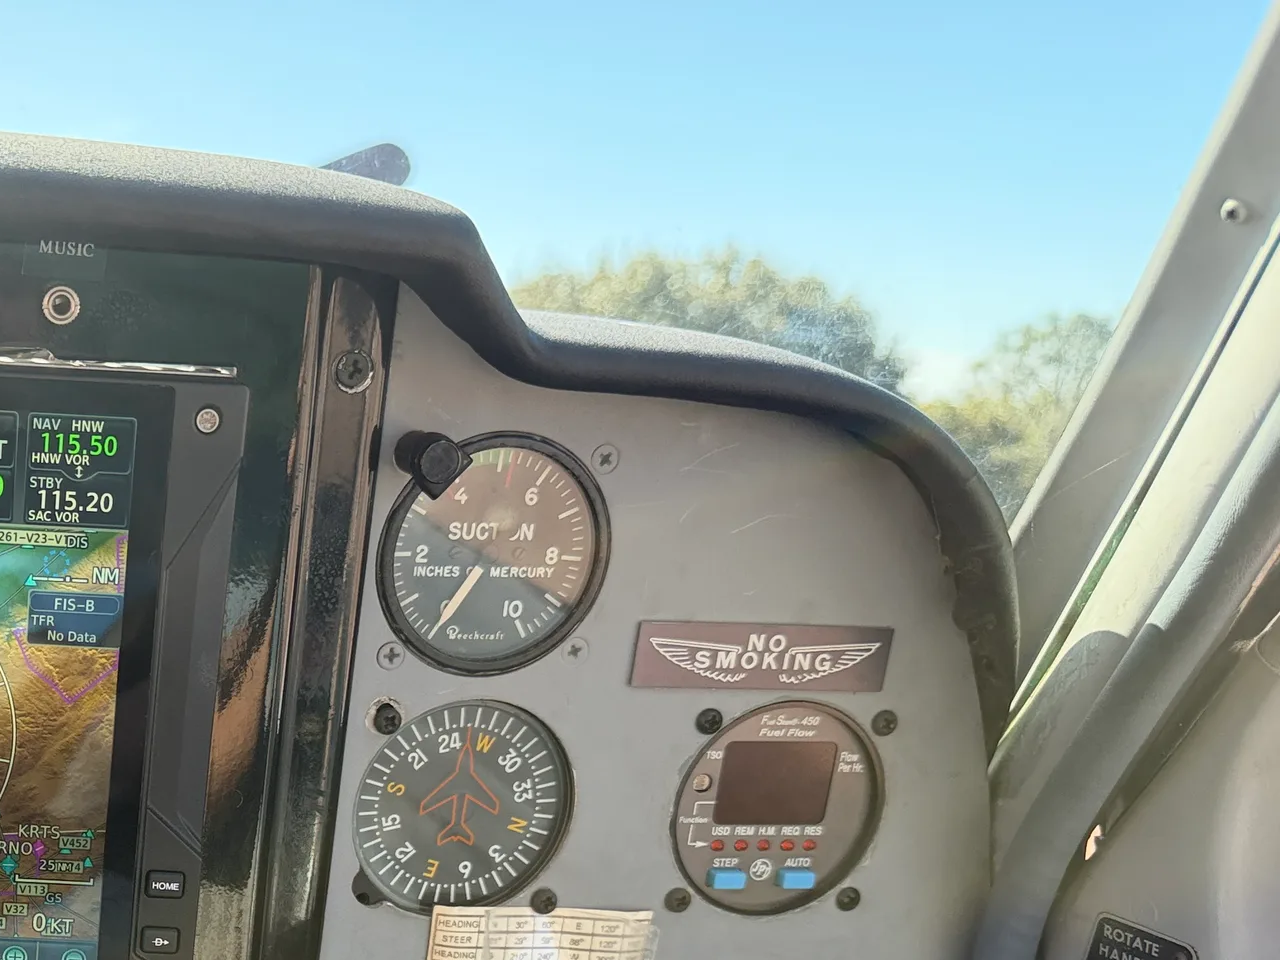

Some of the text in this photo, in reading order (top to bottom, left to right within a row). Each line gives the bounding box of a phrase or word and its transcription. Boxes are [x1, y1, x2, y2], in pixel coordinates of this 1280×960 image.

[39, 240, 94, 257] MUSIC
[33, 418, 104, 432] NAV HNW
[41, 432, 118, 456] 115.50
[29, 477, 63, 490] STBY
[38, 490, 113, 512] 115.20
[525, 487, 538, 505] 6
[28, 510, 79, 523] SAC VOR
[545, 547, 558, 564] 8
[413, 566, 459, 578] INCHES
[489, 566, 554, 578] MERCURY
[54, 598, 94, 612] FIS-B
[503, 600, 523, 618] 10
[31, 615, 54, 626] TFR
[47, 630, 96, 643] No Data
[446, 626, 504, 640] Beechcraft
[748, 633, 787, 653] NO
[694, 651, 833, 672] SMOKING
[759, 729, 816, 737] Fuel Flow
[438, 732, 462, 753] 24
[498, 751, 522, 773] 30
[19, 824, 61, 839] KRTS
[713, 858, 738, 867] STEP
[785, 858, 811, 867] AUTO
[152, 882, 179, 891] HOME
[438, 919, 479, 929] HEADING
[442, 935, 472, 944] STEER
[1103, 924, 1159, 957] ROTATE
